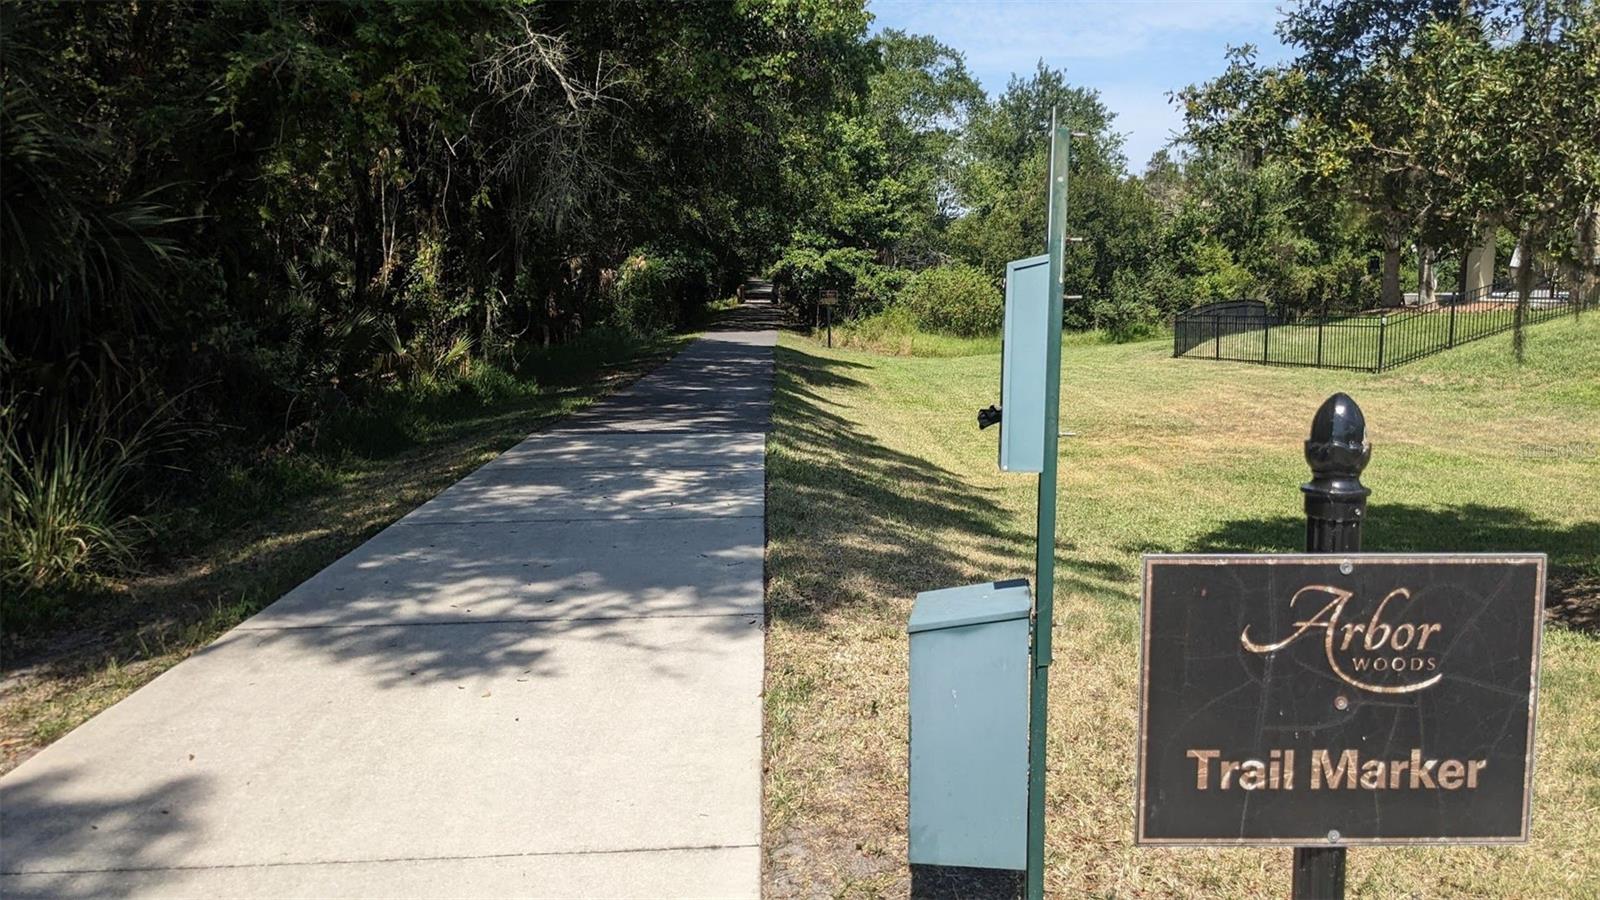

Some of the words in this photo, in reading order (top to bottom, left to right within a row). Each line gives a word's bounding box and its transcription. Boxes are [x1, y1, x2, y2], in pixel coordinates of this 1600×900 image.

[1240, 585, 1442, 693] Arbor
[1352, 656, 1436, 672] WOODS
[1186, 749, 1295, 791] Trail
[1310, 749, 1487, 791] Marker
